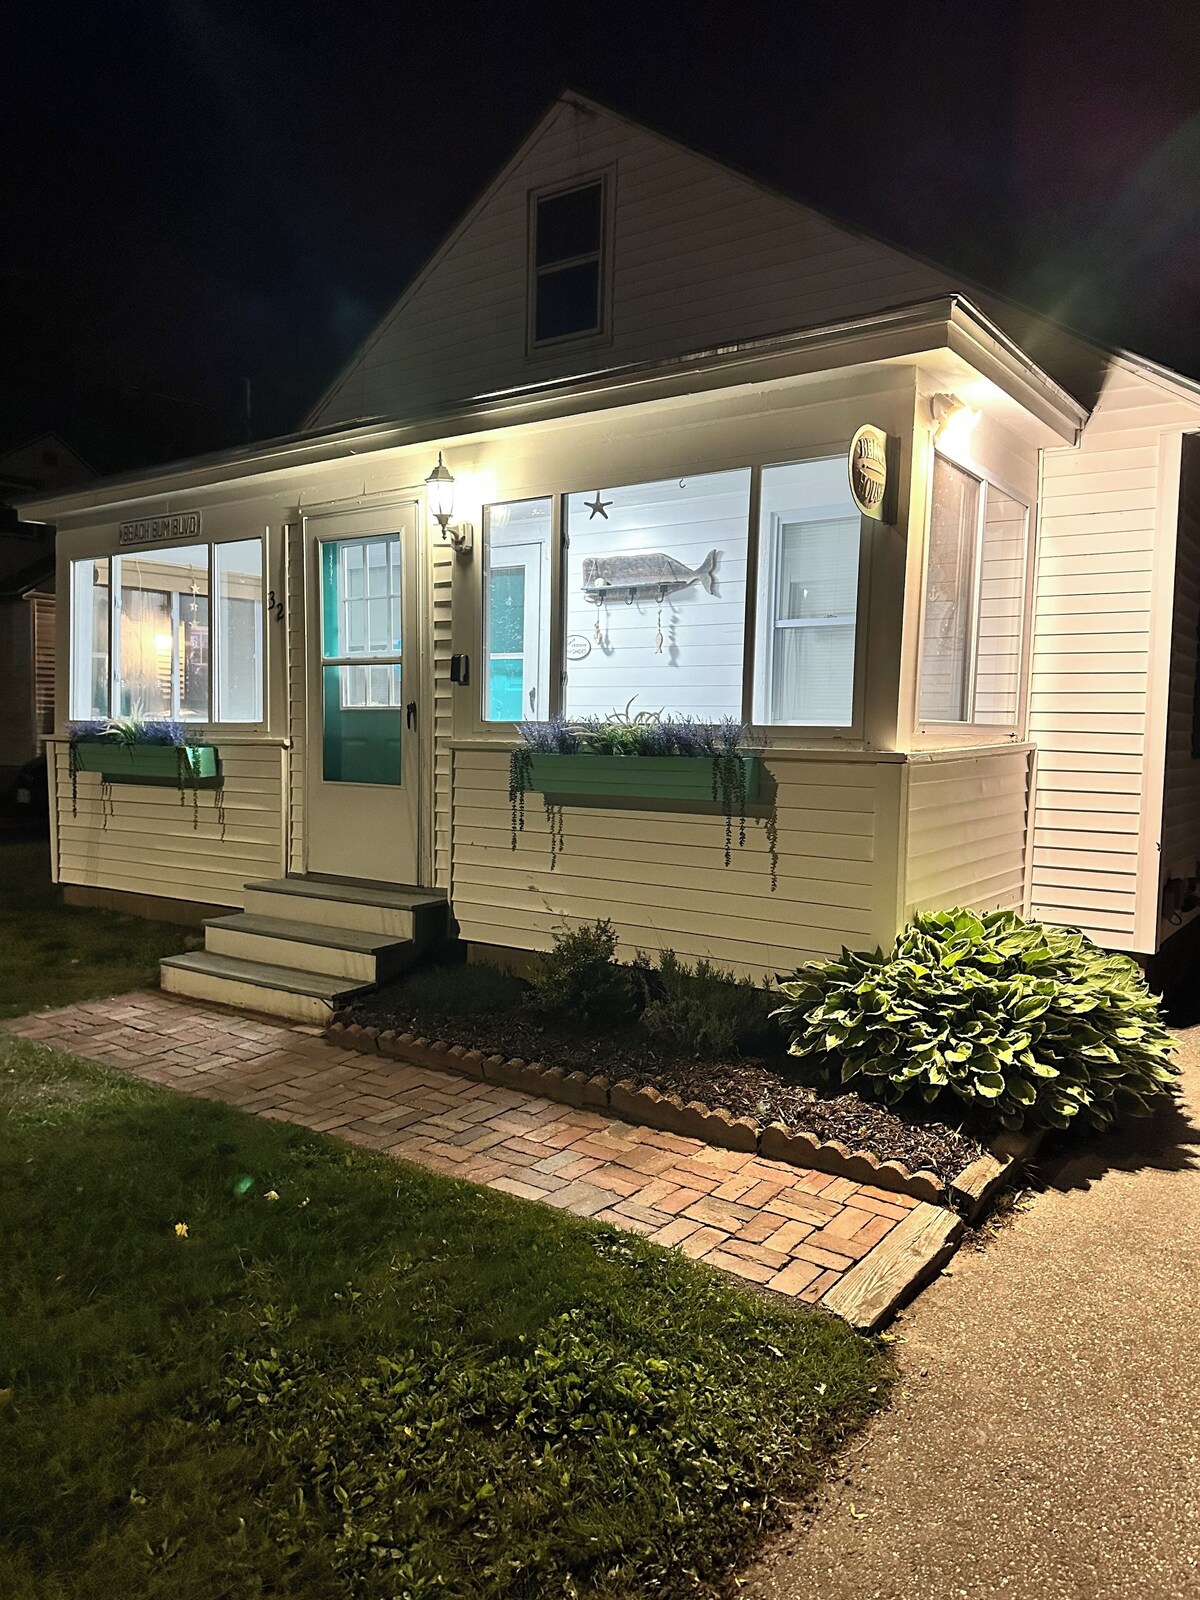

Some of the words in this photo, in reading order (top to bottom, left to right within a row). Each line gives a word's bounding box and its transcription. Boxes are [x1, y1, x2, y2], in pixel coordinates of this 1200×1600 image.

[123, 521, 151, 542] BEACH
[152, 518, 172, 538] BUM
[173, 515, 197, 536] BLVD
[268, 590, 285, 622] 32
